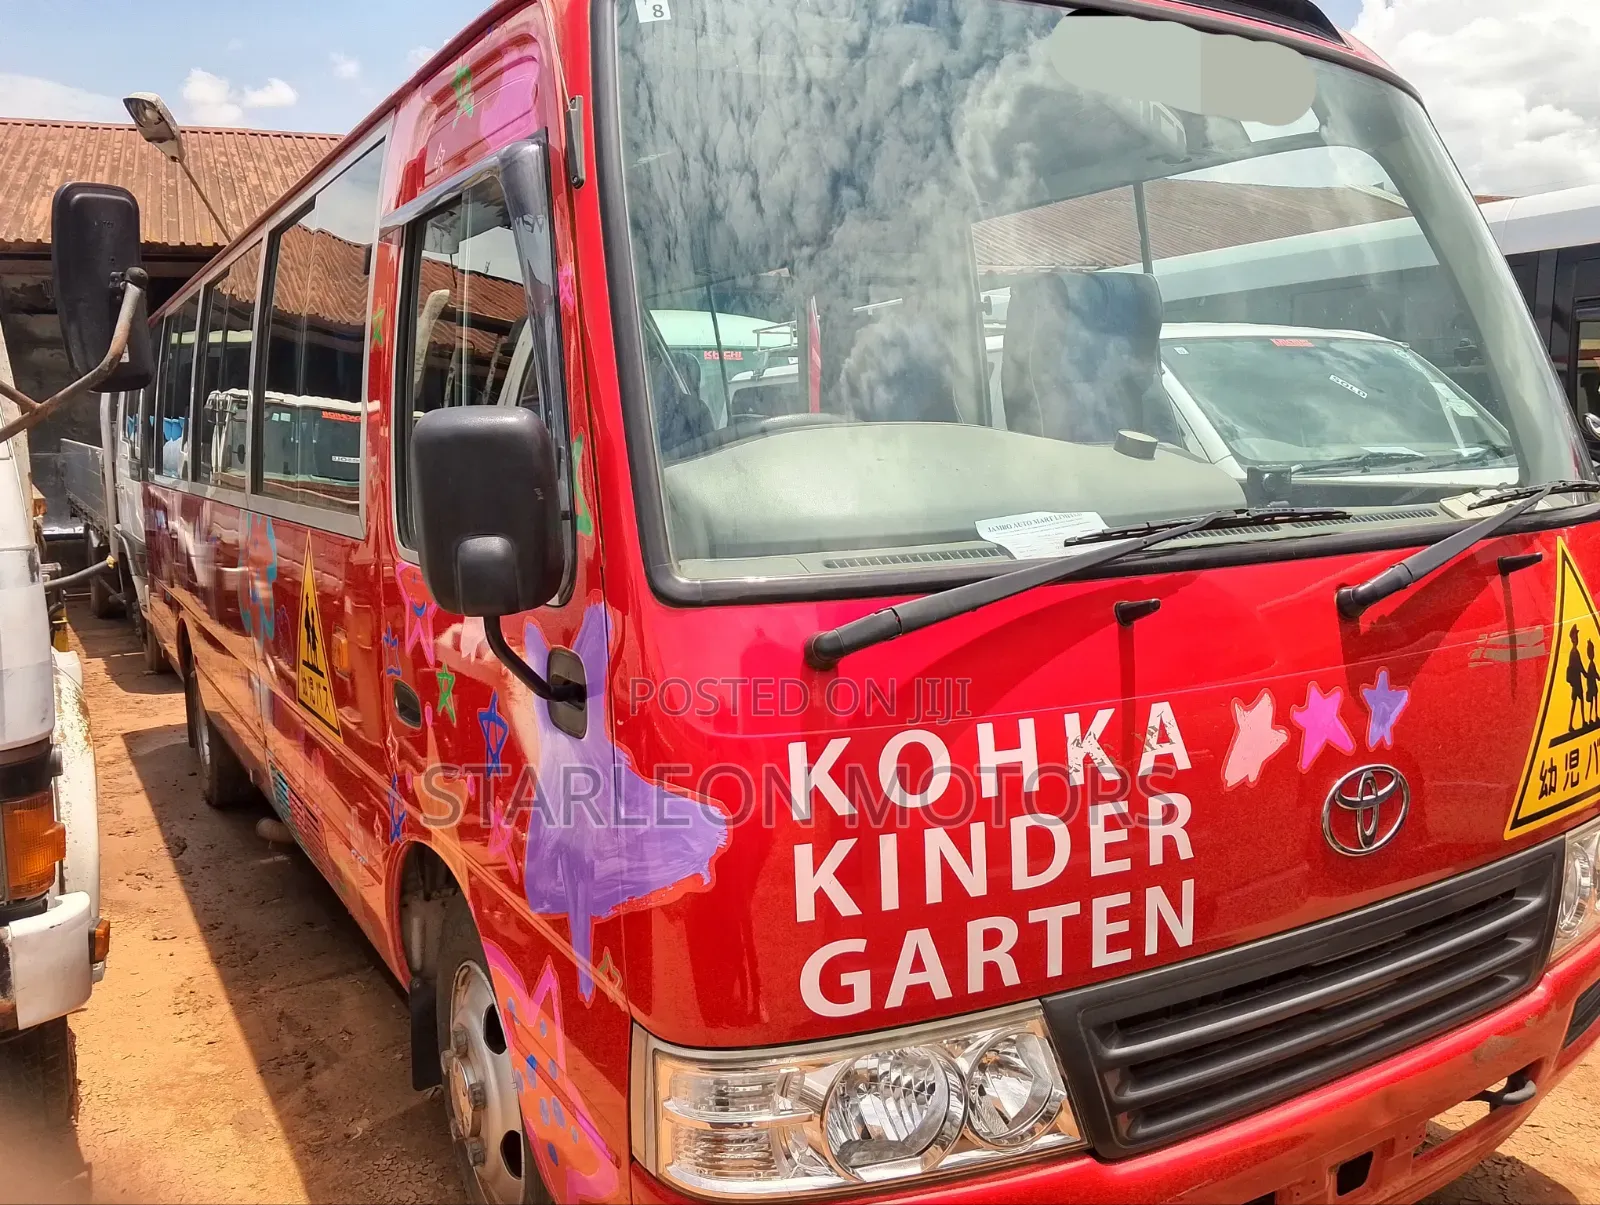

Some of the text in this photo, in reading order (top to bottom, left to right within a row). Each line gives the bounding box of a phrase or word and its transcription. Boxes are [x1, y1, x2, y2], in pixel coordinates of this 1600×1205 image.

[1331, 375, 1366, 397] SOLD
[987, 523, 1013, 533] JAMBO
[1013, 520, 1032, 530] AUTO
[1032, 517, 1053, 526] MART
[787, 701, 1192, 821] KOHKA
[793, 792, 1195, 922] KINDER
[800, 878, 1195, 1017] GARTEN
